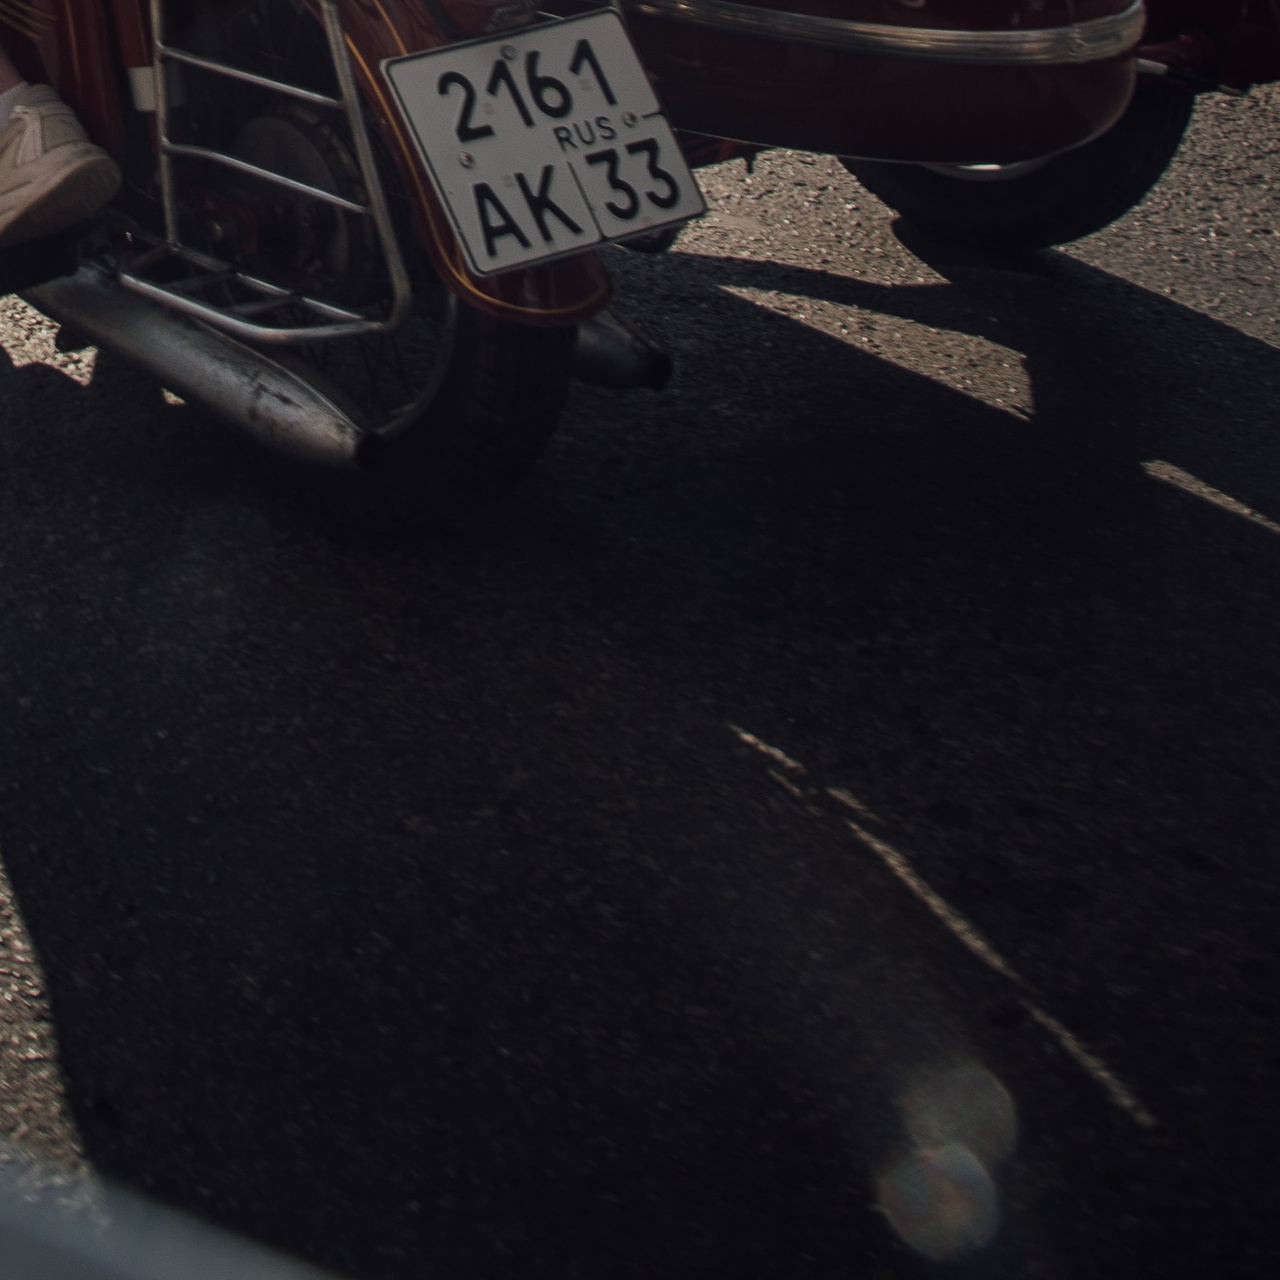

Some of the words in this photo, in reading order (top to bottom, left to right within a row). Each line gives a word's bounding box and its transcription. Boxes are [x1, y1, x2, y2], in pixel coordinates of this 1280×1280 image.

[437, 38, 619, 144] 2161
[552, 114, 618, 153] RUS
[584, 137, 681, 220] 33
